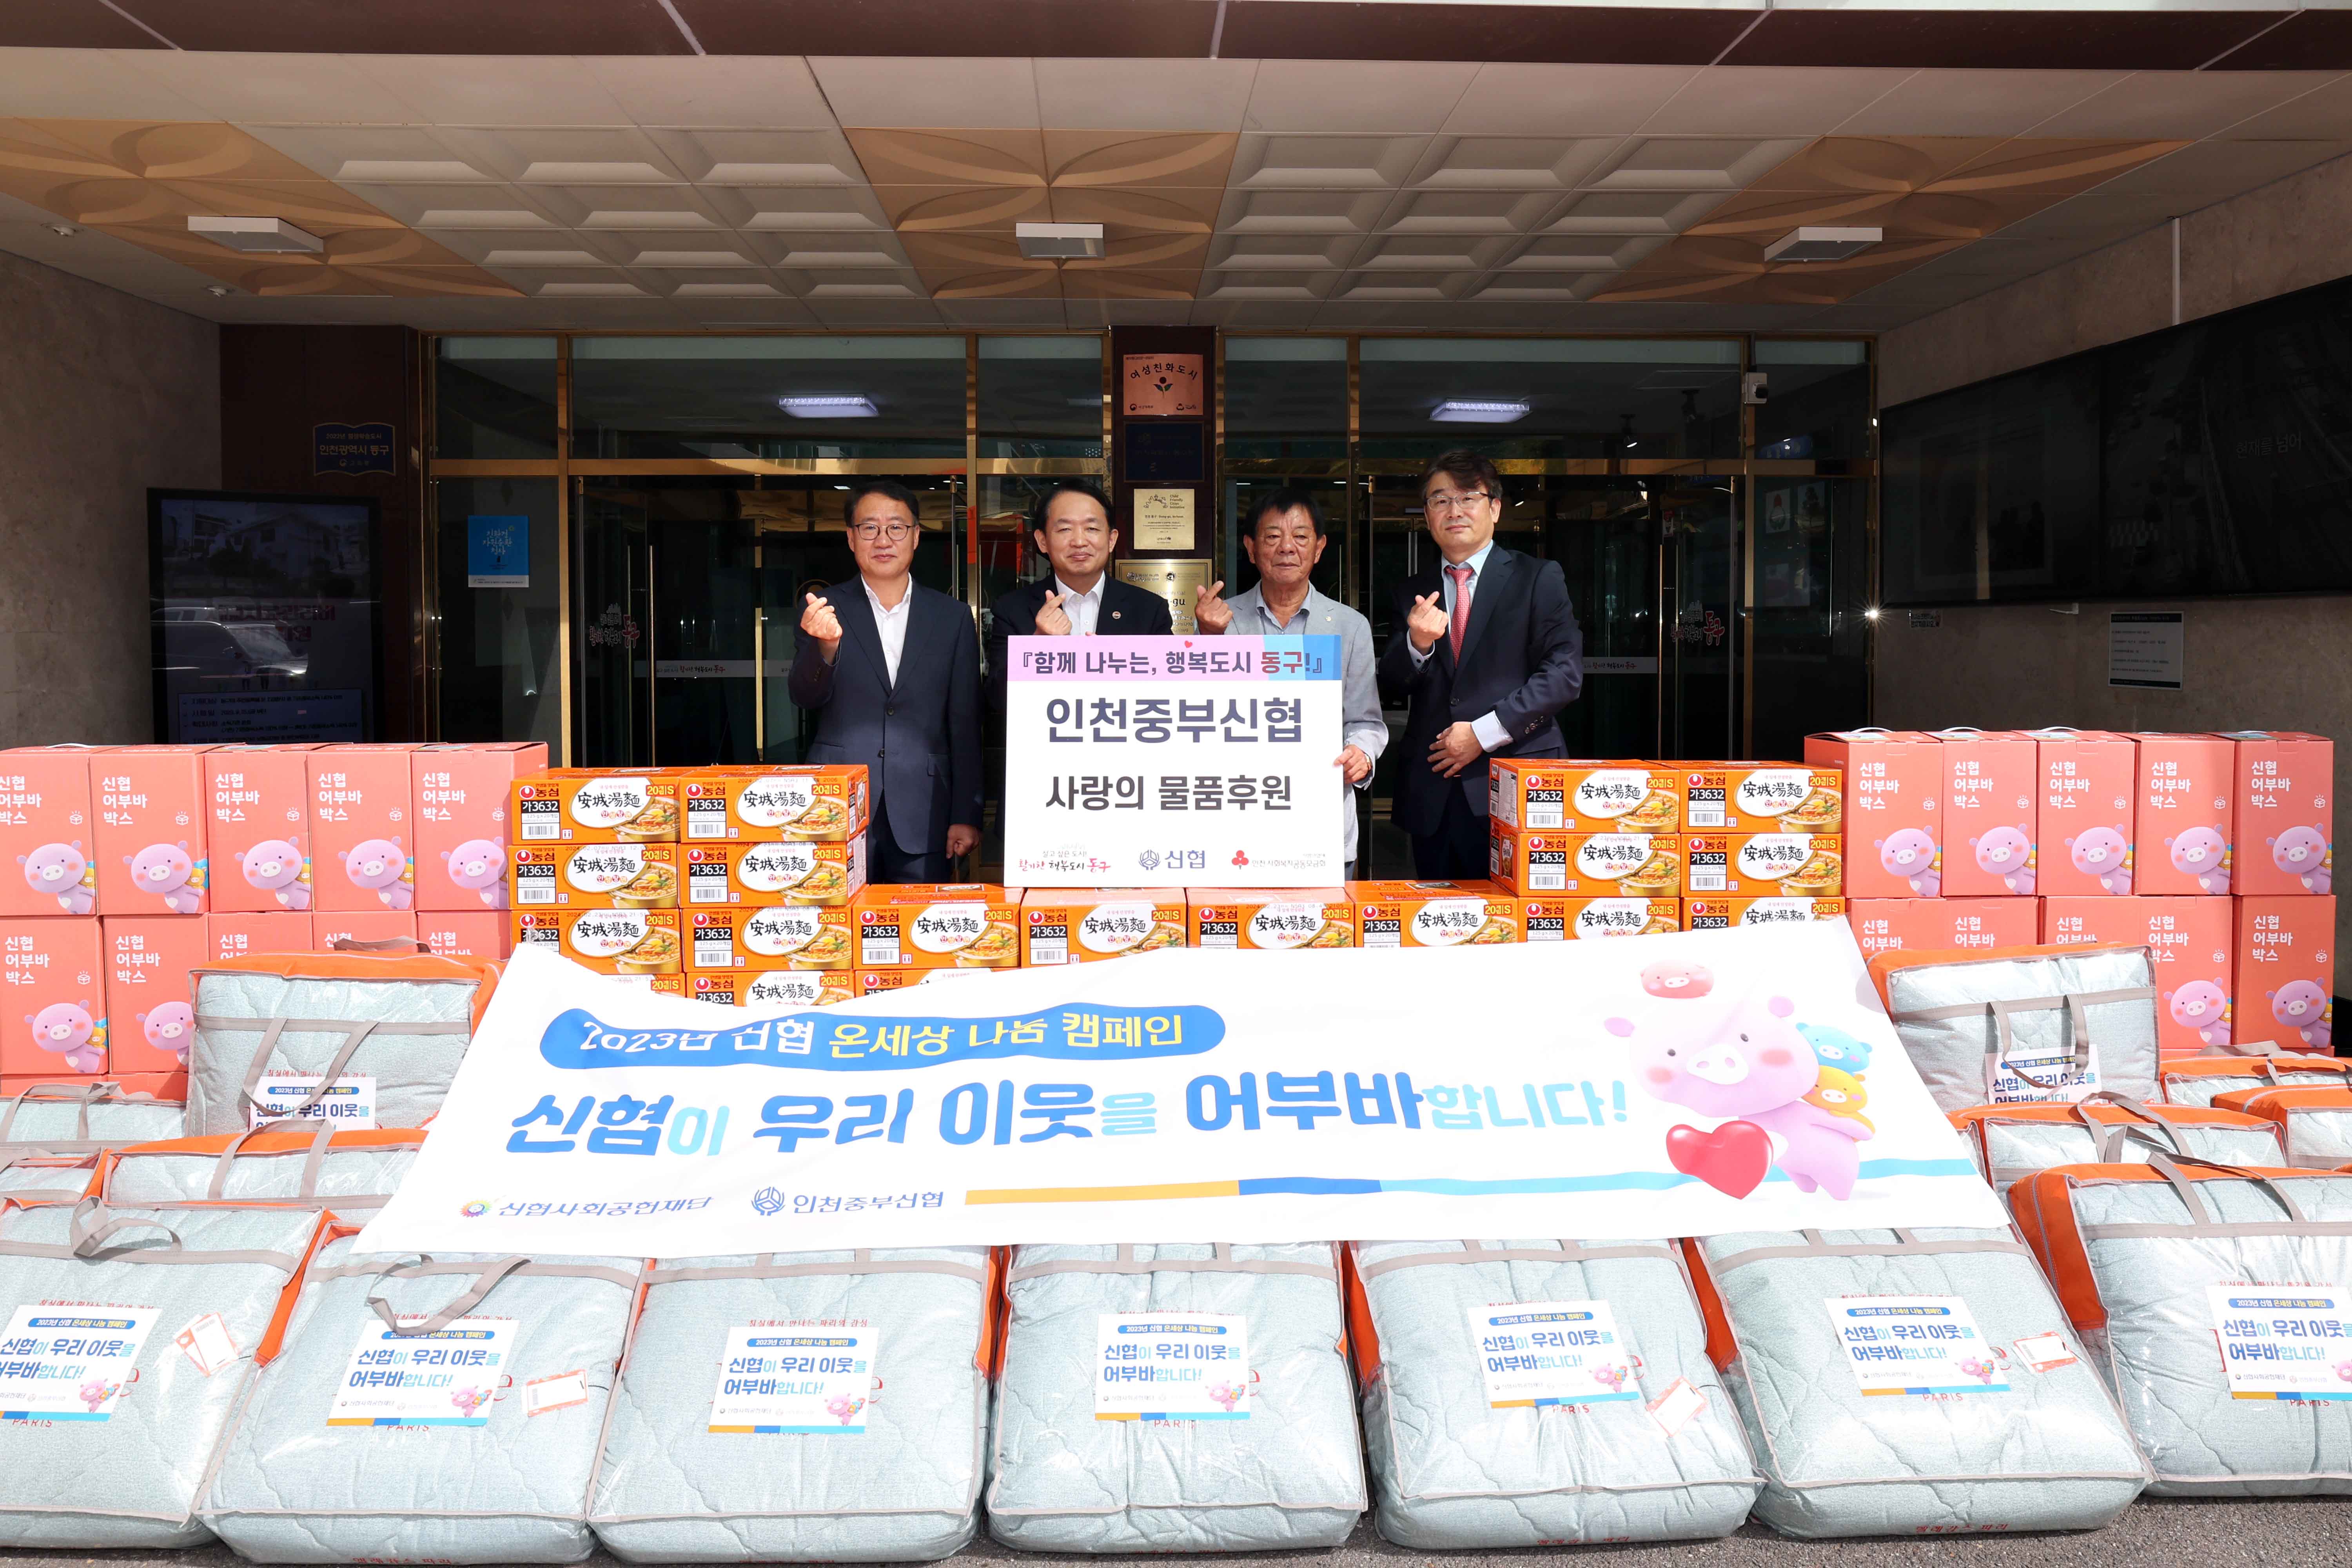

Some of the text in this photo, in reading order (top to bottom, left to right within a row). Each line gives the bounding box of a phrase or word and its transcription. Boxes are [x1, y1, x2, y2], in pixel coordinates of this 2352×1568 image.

[1131, 363, 1198, 379] 여성친화도시
[320, 445, 389, 456] 인천광역시 동구
[1086, 652, 1157, 675] 나누는,
[1166, 651, 1251, 674] 행복도시
[1046, 697, 1302, 744] 인천중부신협
[1860, 762, 1886, 777] 신협
[1954, 761, 1980, 776] 신협
[2152, 762, 2177, 776] 신협
[2251, 761, 2277, 776] 신협
[102, 777, 131, 792] 신협
[216, 773, 243, 789] 신협
[423, 772, 450, 788] 신협
[1542, 778, 1563, 787] 농심
[1704, 776, 1725, 785] 농심
[1859, 779, 1900, 794] 어부바
[1954, 778, 1993, 793] 어부바
[2151, 779, 2191, 793] 어부바
[2251, 778, 2291, 792] 어부바
[423, 789, 465, 804] 어부바
[535, 789, 559, 798] 농심
[703, 786, 726, 795] 농심
[1046, 774, 1291, 811] 사랑의 물품후원
[1528, 790, 1562, 802] 가3632
[1581, 783, 1642, 799] 安城湯麵
[1690, 789, 1724, 800] 가3632
[1743, 781, 1804, 798] 安城湯麵
[103, 793, 147, 809] 어부바
[216, 791, 260, 806] 어부바
[578, 792, 641, 809] 安城湯麵
[689, 800, 725, 811] 가3632
[744, 791, 807, 807] 安城湯麵
[1860, 797, 1886, 811] 박스
[1954, 795, 1980, 809] 박스
[2151, 795, 2176, 809] 박스
[2251, 795, 2277, 808] 박스
[423, 807, 451, 821] 박스
[523, 801, 558, 812] 가3632
[103, 812, 133, 826] 박스
[216, 809, 245, 823] 박스
[1049, 859, 1085, 872] 행복도시
[1087, 858, 1111, 873] 동구
[1165, 850, 1206, 869] 신협
[877, 913, 899, 922] 농심
[1256, 915, 1318, 931] 安城湯麵
[2254, 916, 2279, 929] 신협
[863, 926, 898, 937] 가3632
[917, 917, 980, 934] 安城湯麵
[1202, 923, 1236, 934] 가3632
[5, 936, 33, 951] 신협
[2253, 932, 2293, 946] 어부바
[5, 954, 50, 968] 어부바
[2252, 949, 2279, 962] 박스
[5, 971, 35, 985] 박스
[829, 1024, 955, 1058] 온세상
[1062, 1012, 1182, 1048] 캠페인
[506, 1070, 1628, 1156] 신협이 우리 이웃을 어부바합니다!
[499, 1196, 714, 1216] 신협사회공헌재단
[793, 1192, 944, 1214] 인천중부신협
[1844, 1324, 1976, 1341] 신협이 우리 이웃을
[2223, 1319, 2352, 1338] 신협이 우리 이웃을
[1, 1338, 136, 1357] 신협이 우리 이웃을
[1483, 1329, 1615, 1352] 신협이 우리 이웃을
[358, 1350, 501, 1366] 신협이 우리 이웃을
[1104, 1343, 1241, 1360] 신협이 우리 이웃을
[1852, 1346, 1948, 1362] 어부바합니다!
[2229, 1343, 2326, 1361] 어부바합니다!
[729, 1357, 867, 1374] 신협이 우리 이웃을
[1487, 1354, 1583, 1373] 어부바합니다!
[349, 1371, 454, 1388] 어부바합니다!
[1103, 1366, 1202, 1382] 어부바합니다!
[724, 1379, 824, 1396] 어부바합니다!
[1922, 1393, 1964, 1402] PARIS
[1552, 1404, 1590, 1414] PARIS
[12, 1418, 53, 1428] PARIS
